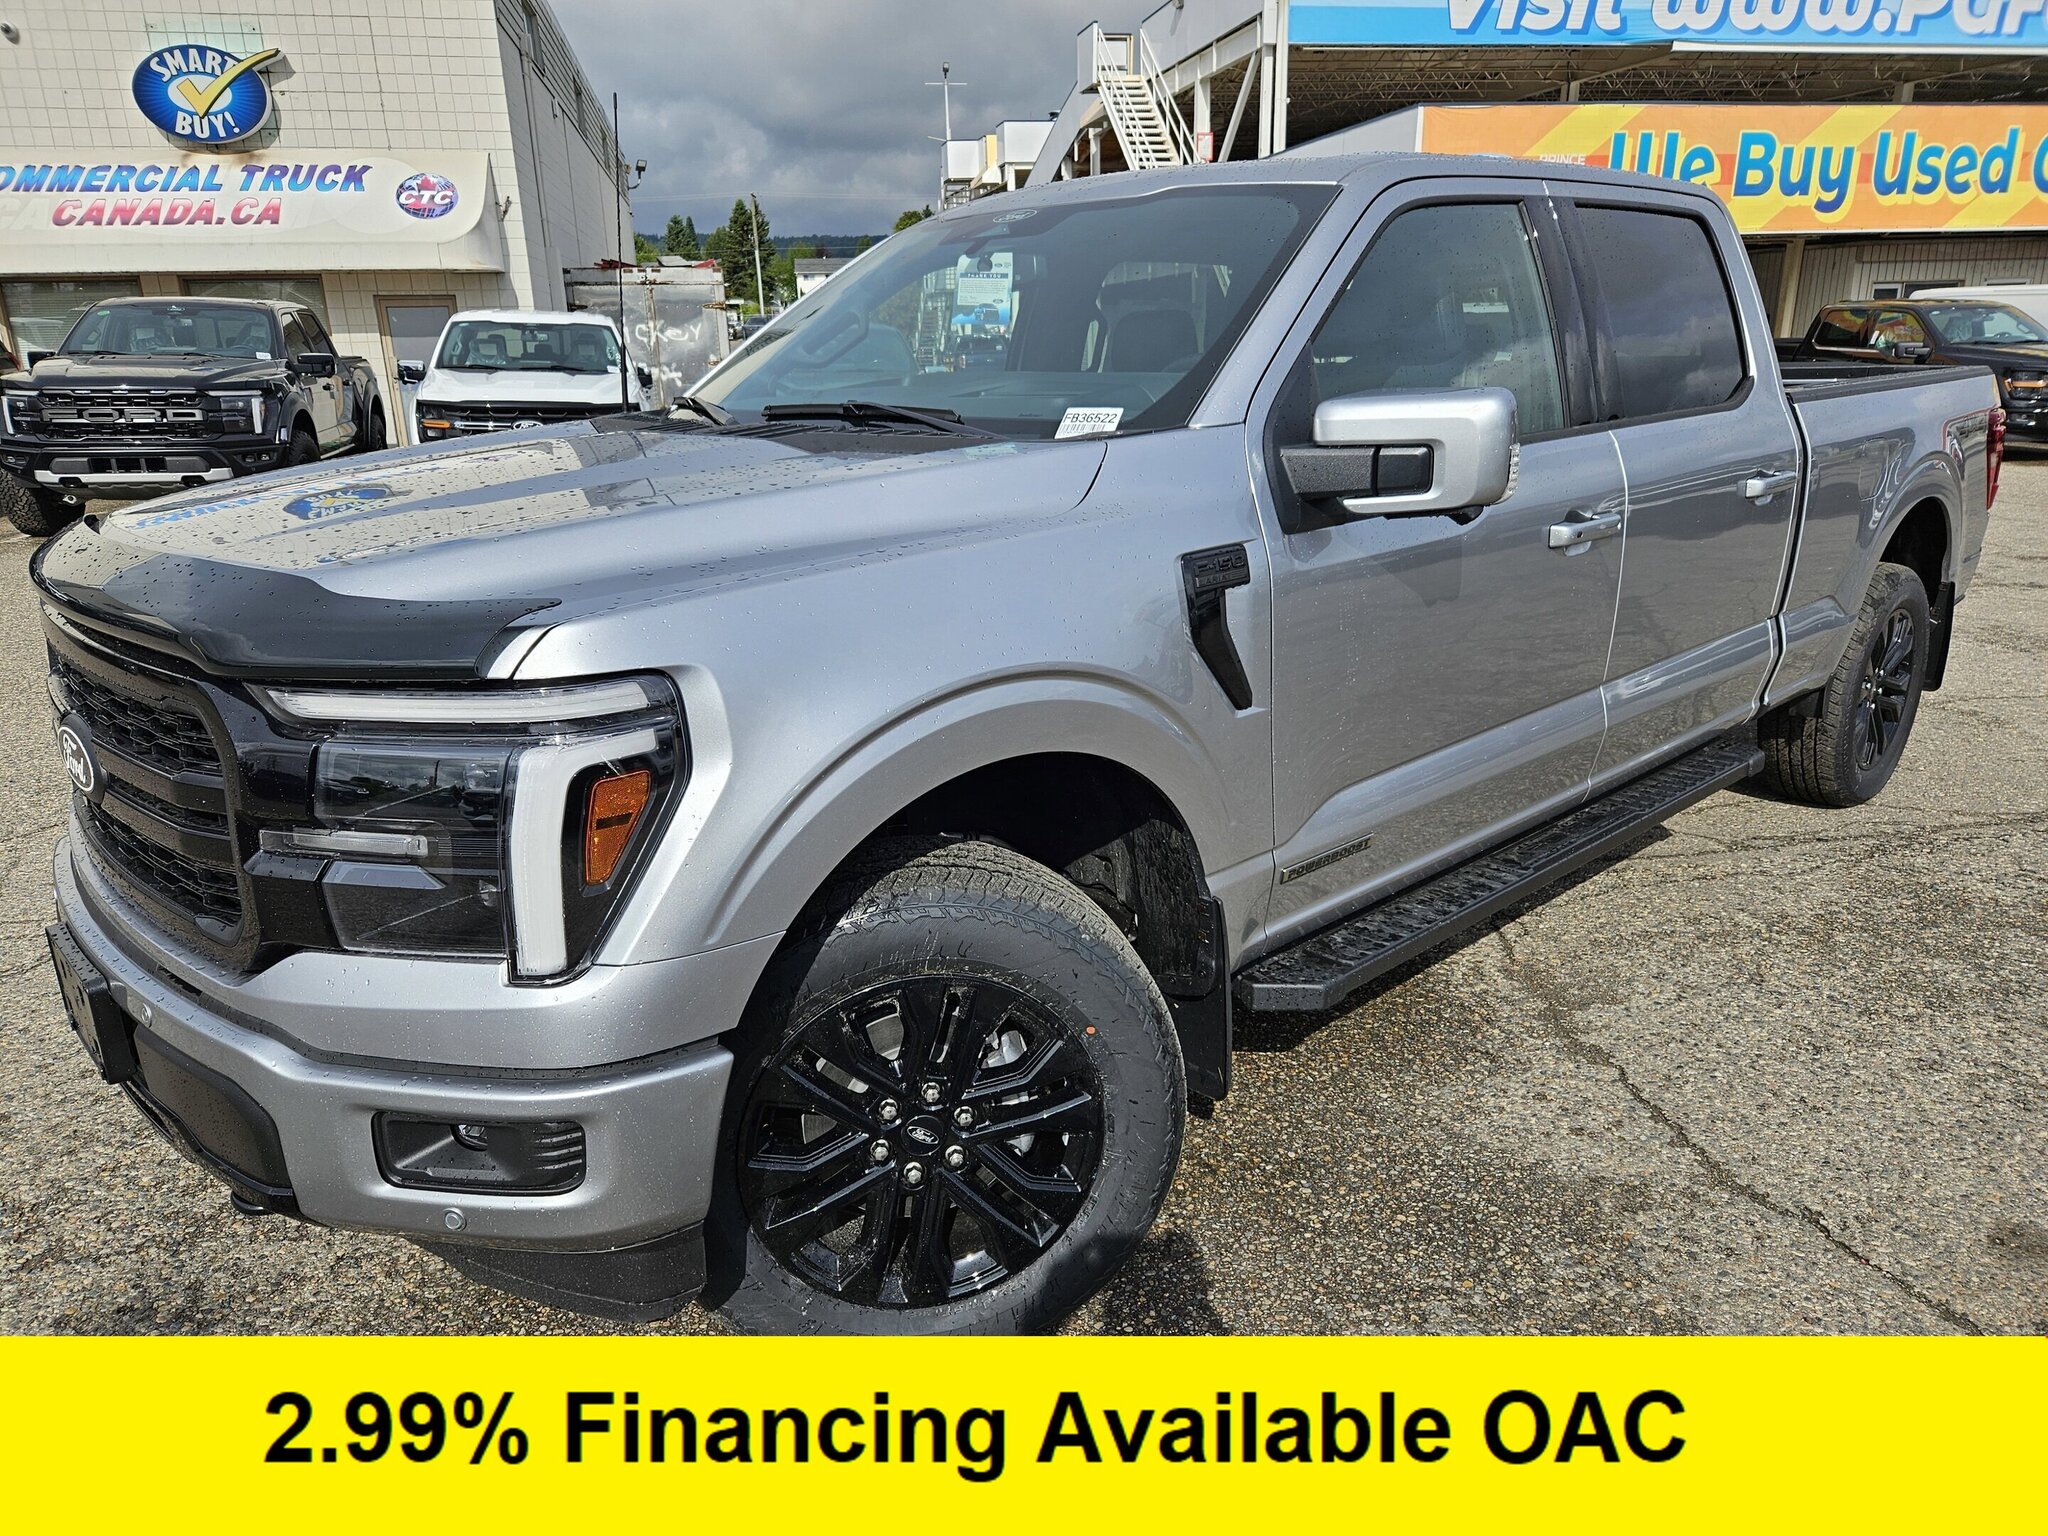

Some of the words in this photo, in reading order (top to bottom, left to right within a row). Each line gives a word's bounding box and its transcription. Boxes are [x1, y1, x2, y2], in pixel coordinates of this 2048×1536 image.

[150, 48, 240, 82] SMART
[175, 110, 240, 139] BUY!
[240, 164, 373, 192] TRUCK
[1610, 131, 1715, 183] We
[1732, 131, 1856, 214] Buy
[1872, 126, 2021, 197] Used
[52, 197, 282, 227] CANADA.CA
[399, 190, 453, 205] CTC
[41, 408, 204, 422] FORD
[1063, 412, 1118, 424] FB36522
[61, 731, 89, 787] Ford
[1286, 837, 1372, 880] POWERBOOST
[910, 1128, 936, 1143] Ford
